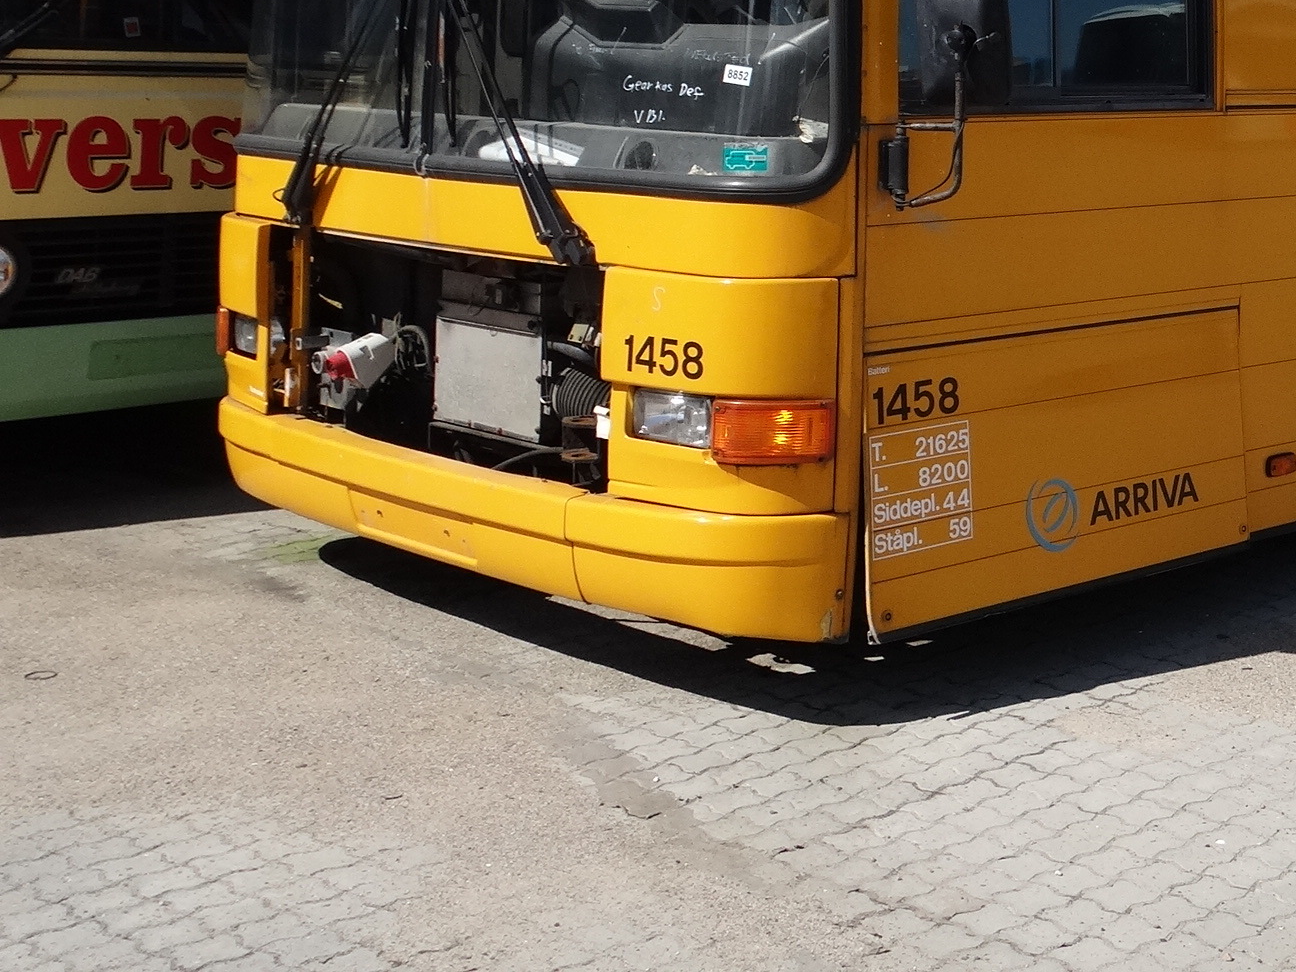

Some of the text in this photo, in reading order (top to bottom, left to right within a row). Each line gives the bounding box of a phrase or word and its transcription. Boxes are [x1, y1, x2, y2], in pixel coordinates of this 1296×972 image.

[727, 69, 750, 82] 8852
[0, 115, 242, 194] vers
[624, 334, 705, 380] 1458
[873, 377, 960, 425] 1458
[871, 429, 969, 462] T. 21625
[873, 459, 969, 493] L. 8200
[873, 488, 970, 524] Siddepl. 44
[1090, 471, 1200, 526] ARRIVA
[874, 516, 971, 554] Ståpl. 59
